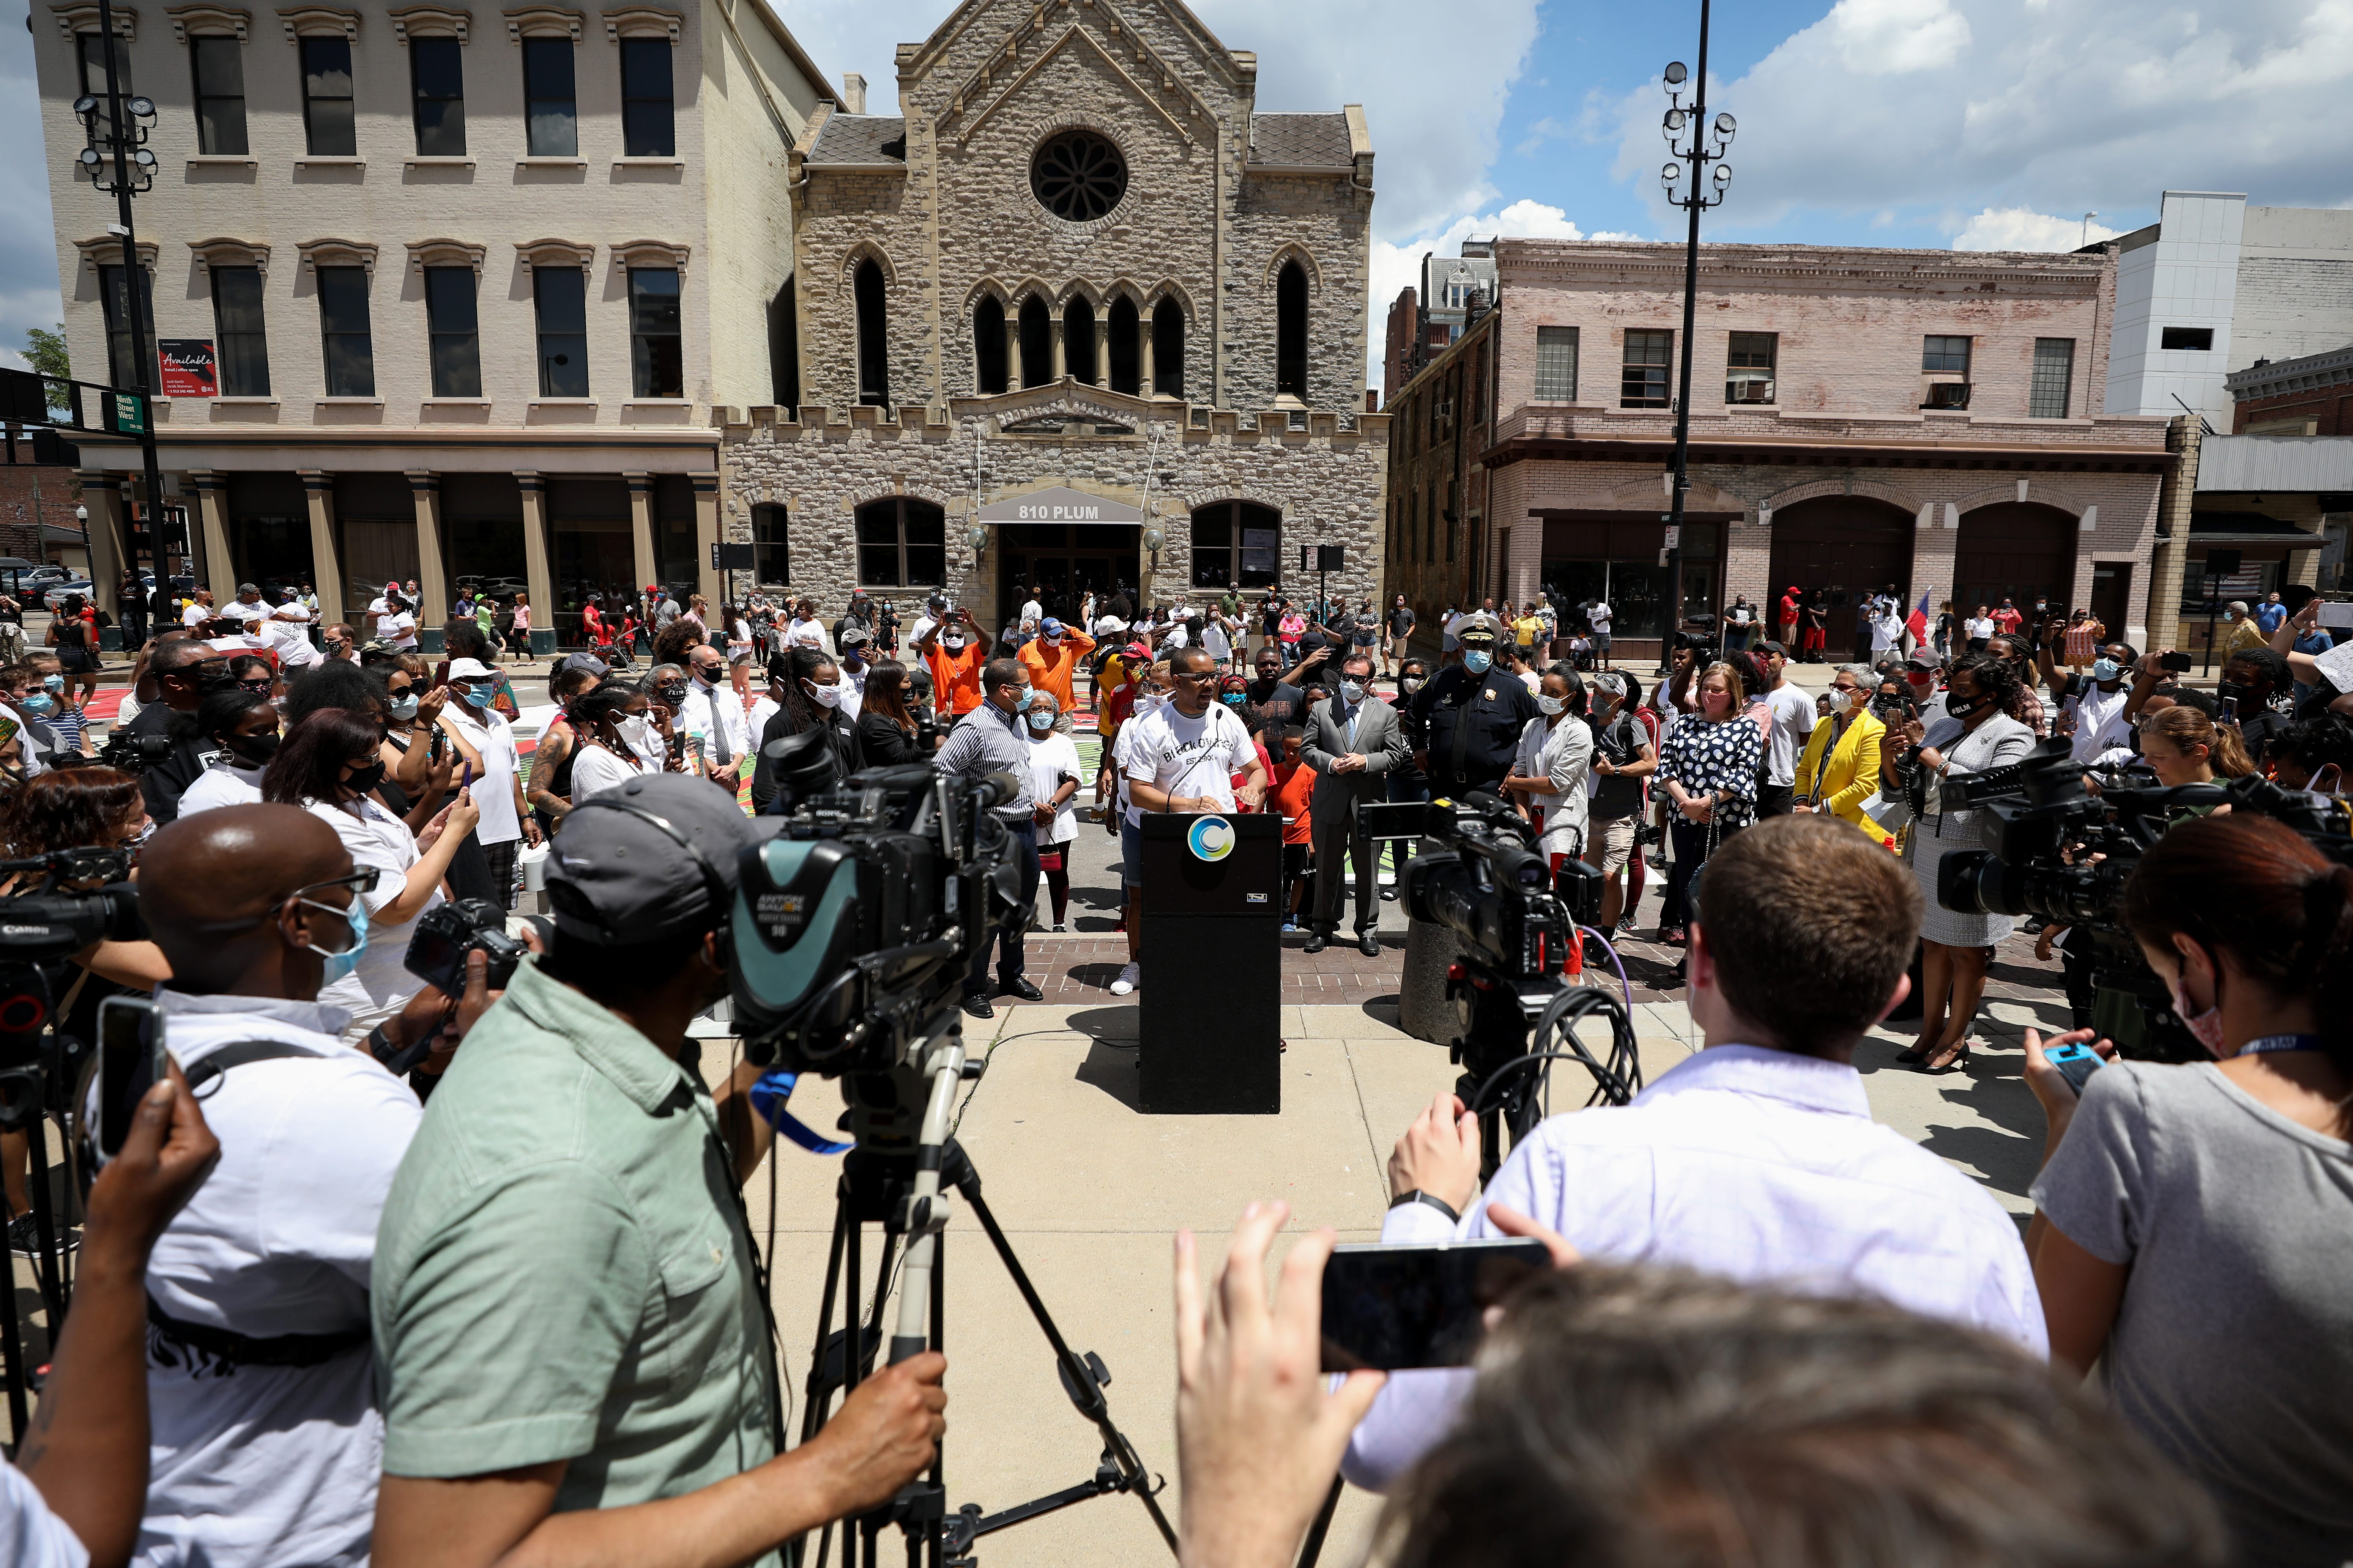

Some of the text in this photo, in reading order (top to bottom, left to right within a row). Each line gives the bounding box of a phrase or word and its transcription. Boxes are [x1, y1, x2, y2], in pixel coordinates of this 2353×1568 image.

[163, 353, 213, 367] Available
[116, 395, 132, 404] Ninth
[117, 403, 135, 412] Street
[118, 410, 134, 420] West
[1019, 505, 1098, 519] 810 PLUM
[2329, 674, 2340, 685] Sick
[1951, 704, 1971, 714] #BLM
[2102, 736, 2126, 749] When
[758, 894, 805, 904] ANTON
[757, 904, 802, 912] BAUER
[2, 924, 50, 935] Canon
